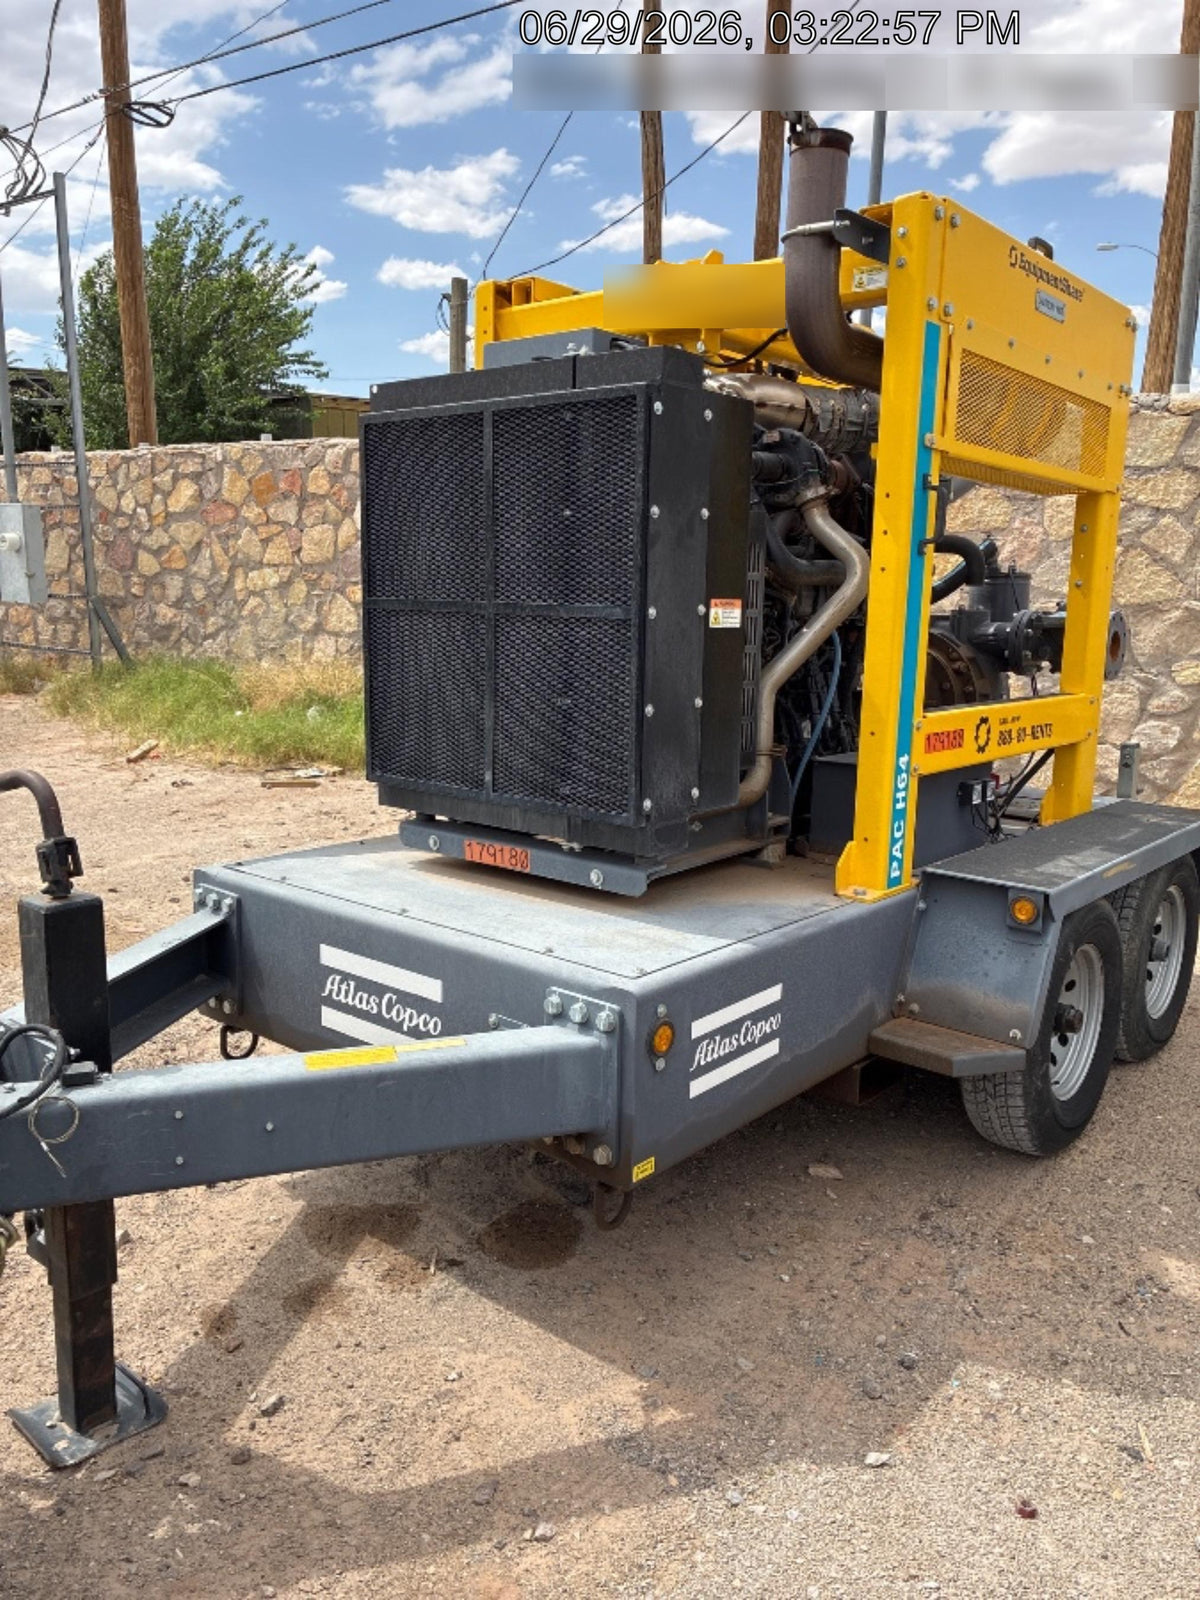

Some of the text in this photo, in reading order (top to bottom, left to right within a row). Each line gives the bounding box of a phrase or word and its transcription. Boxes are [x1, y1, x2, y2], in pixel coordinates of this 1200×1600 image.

[890, 753, 909, 878] PAC H64
[466, 841, 529, 870] 179180
[321, 973, 442, 1035] Atlas Copco
[689, 1013, 782, 1072] Atlas Copco
